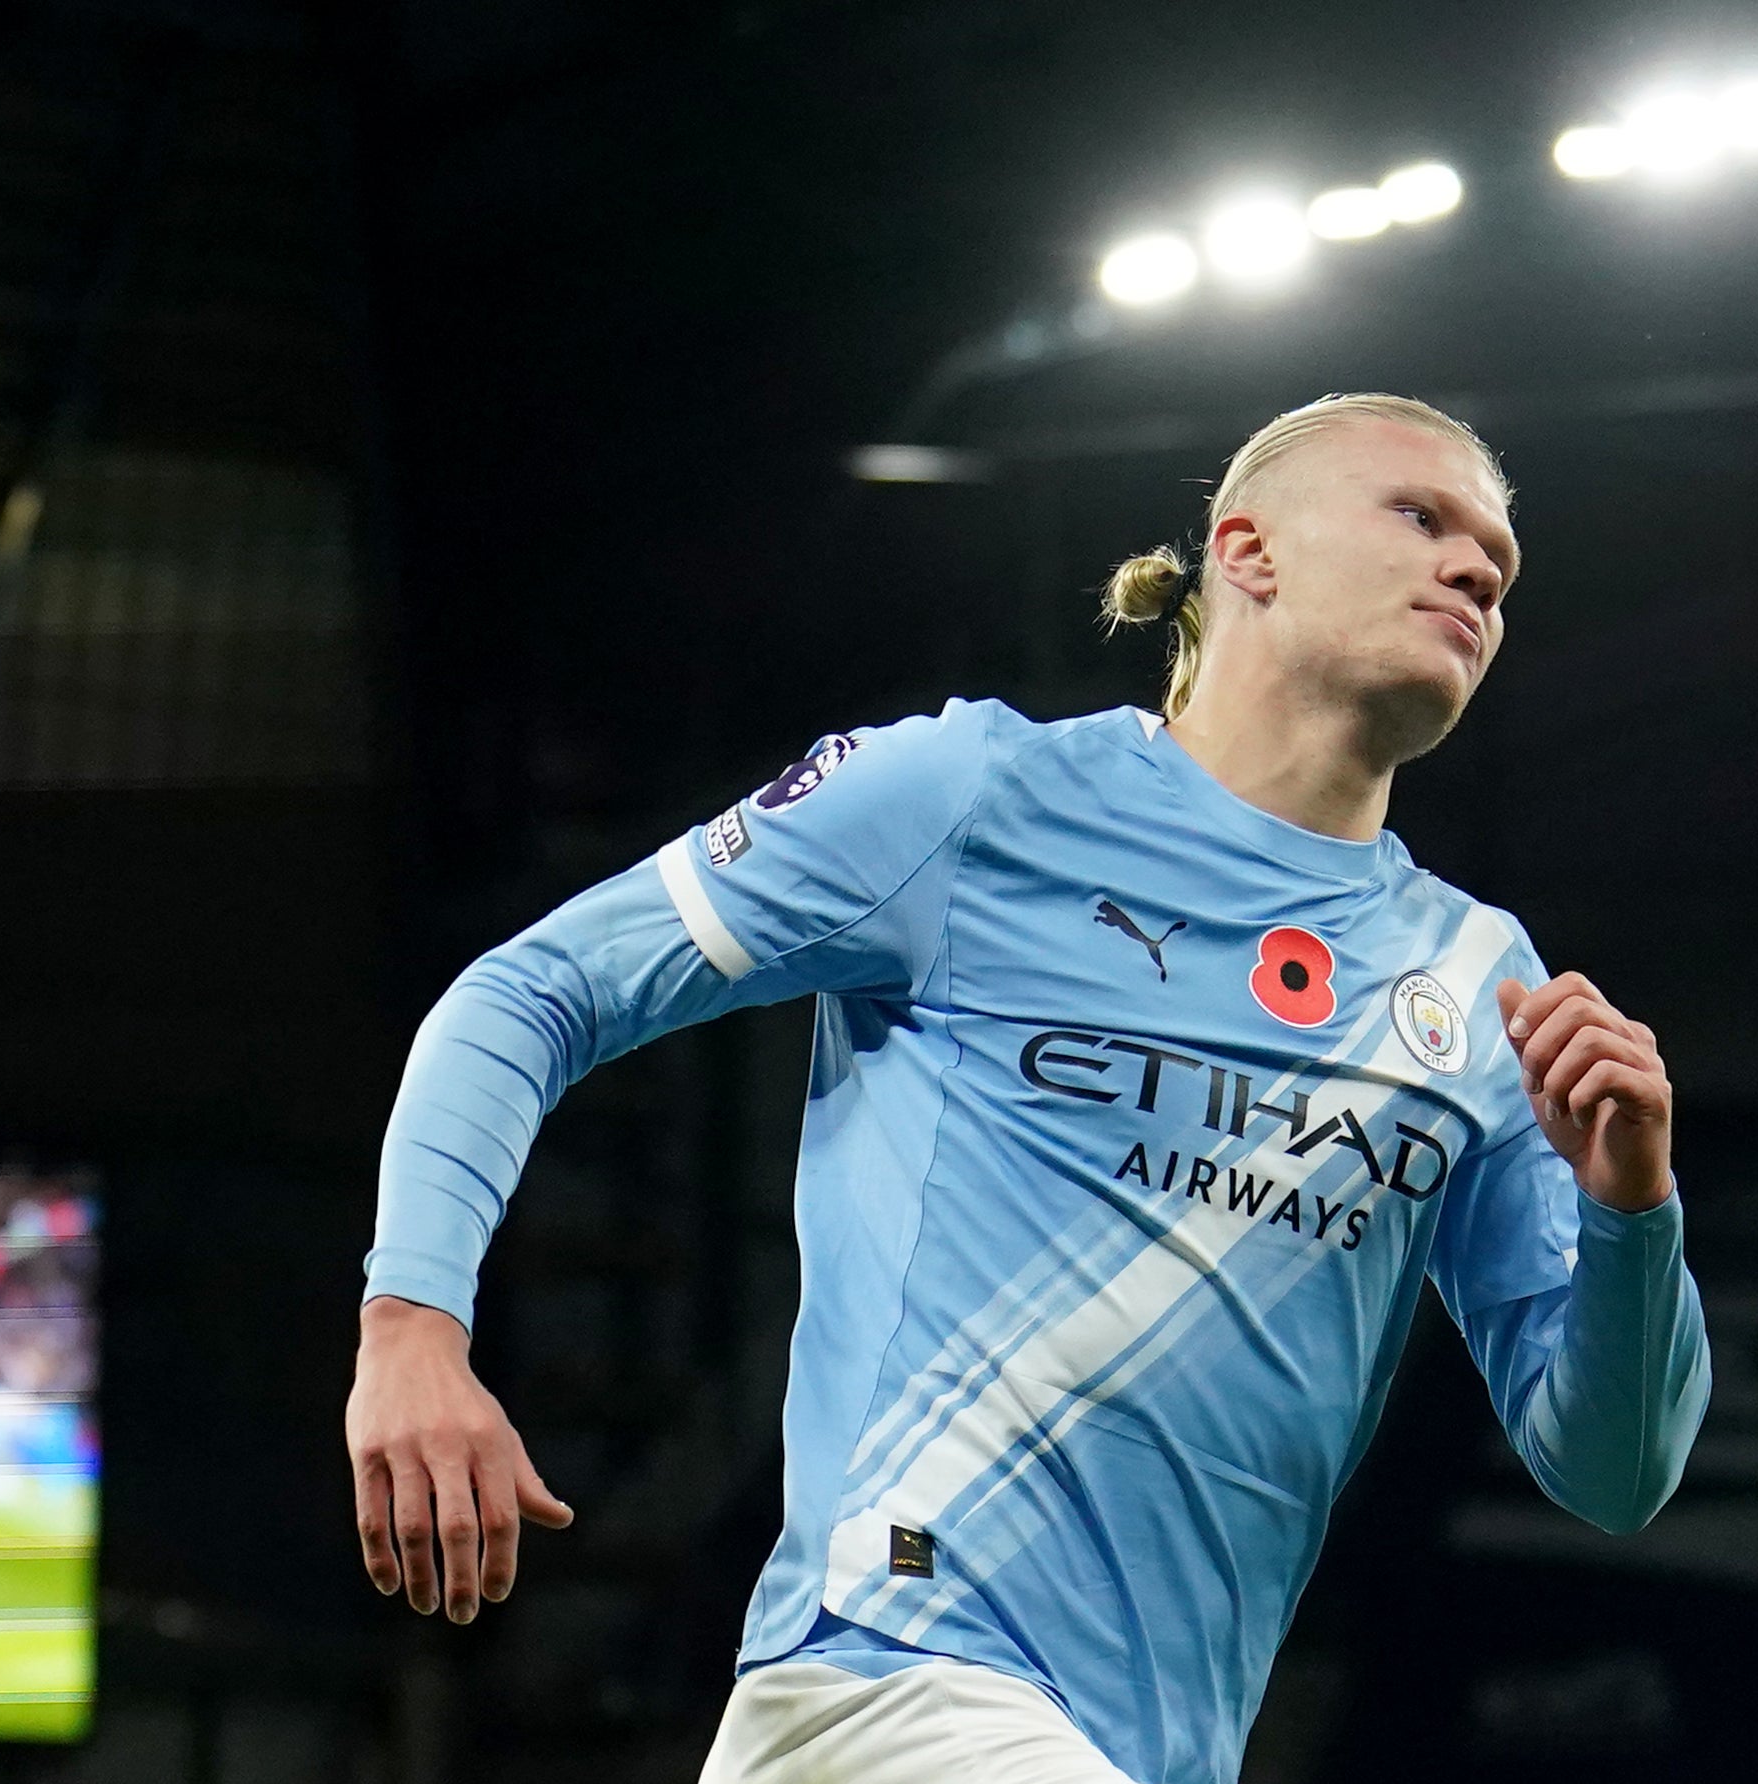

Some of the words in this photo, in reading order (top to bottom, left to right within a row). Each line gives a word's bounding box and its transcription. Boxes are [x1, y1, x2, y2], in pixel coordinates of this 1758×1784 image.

[1019, 1030, 1448, 1202] ETIHAD
[1423, 1053, 1448, 1069] CITY
[1113, 1141, 1369, 1251] AIRWAYS
